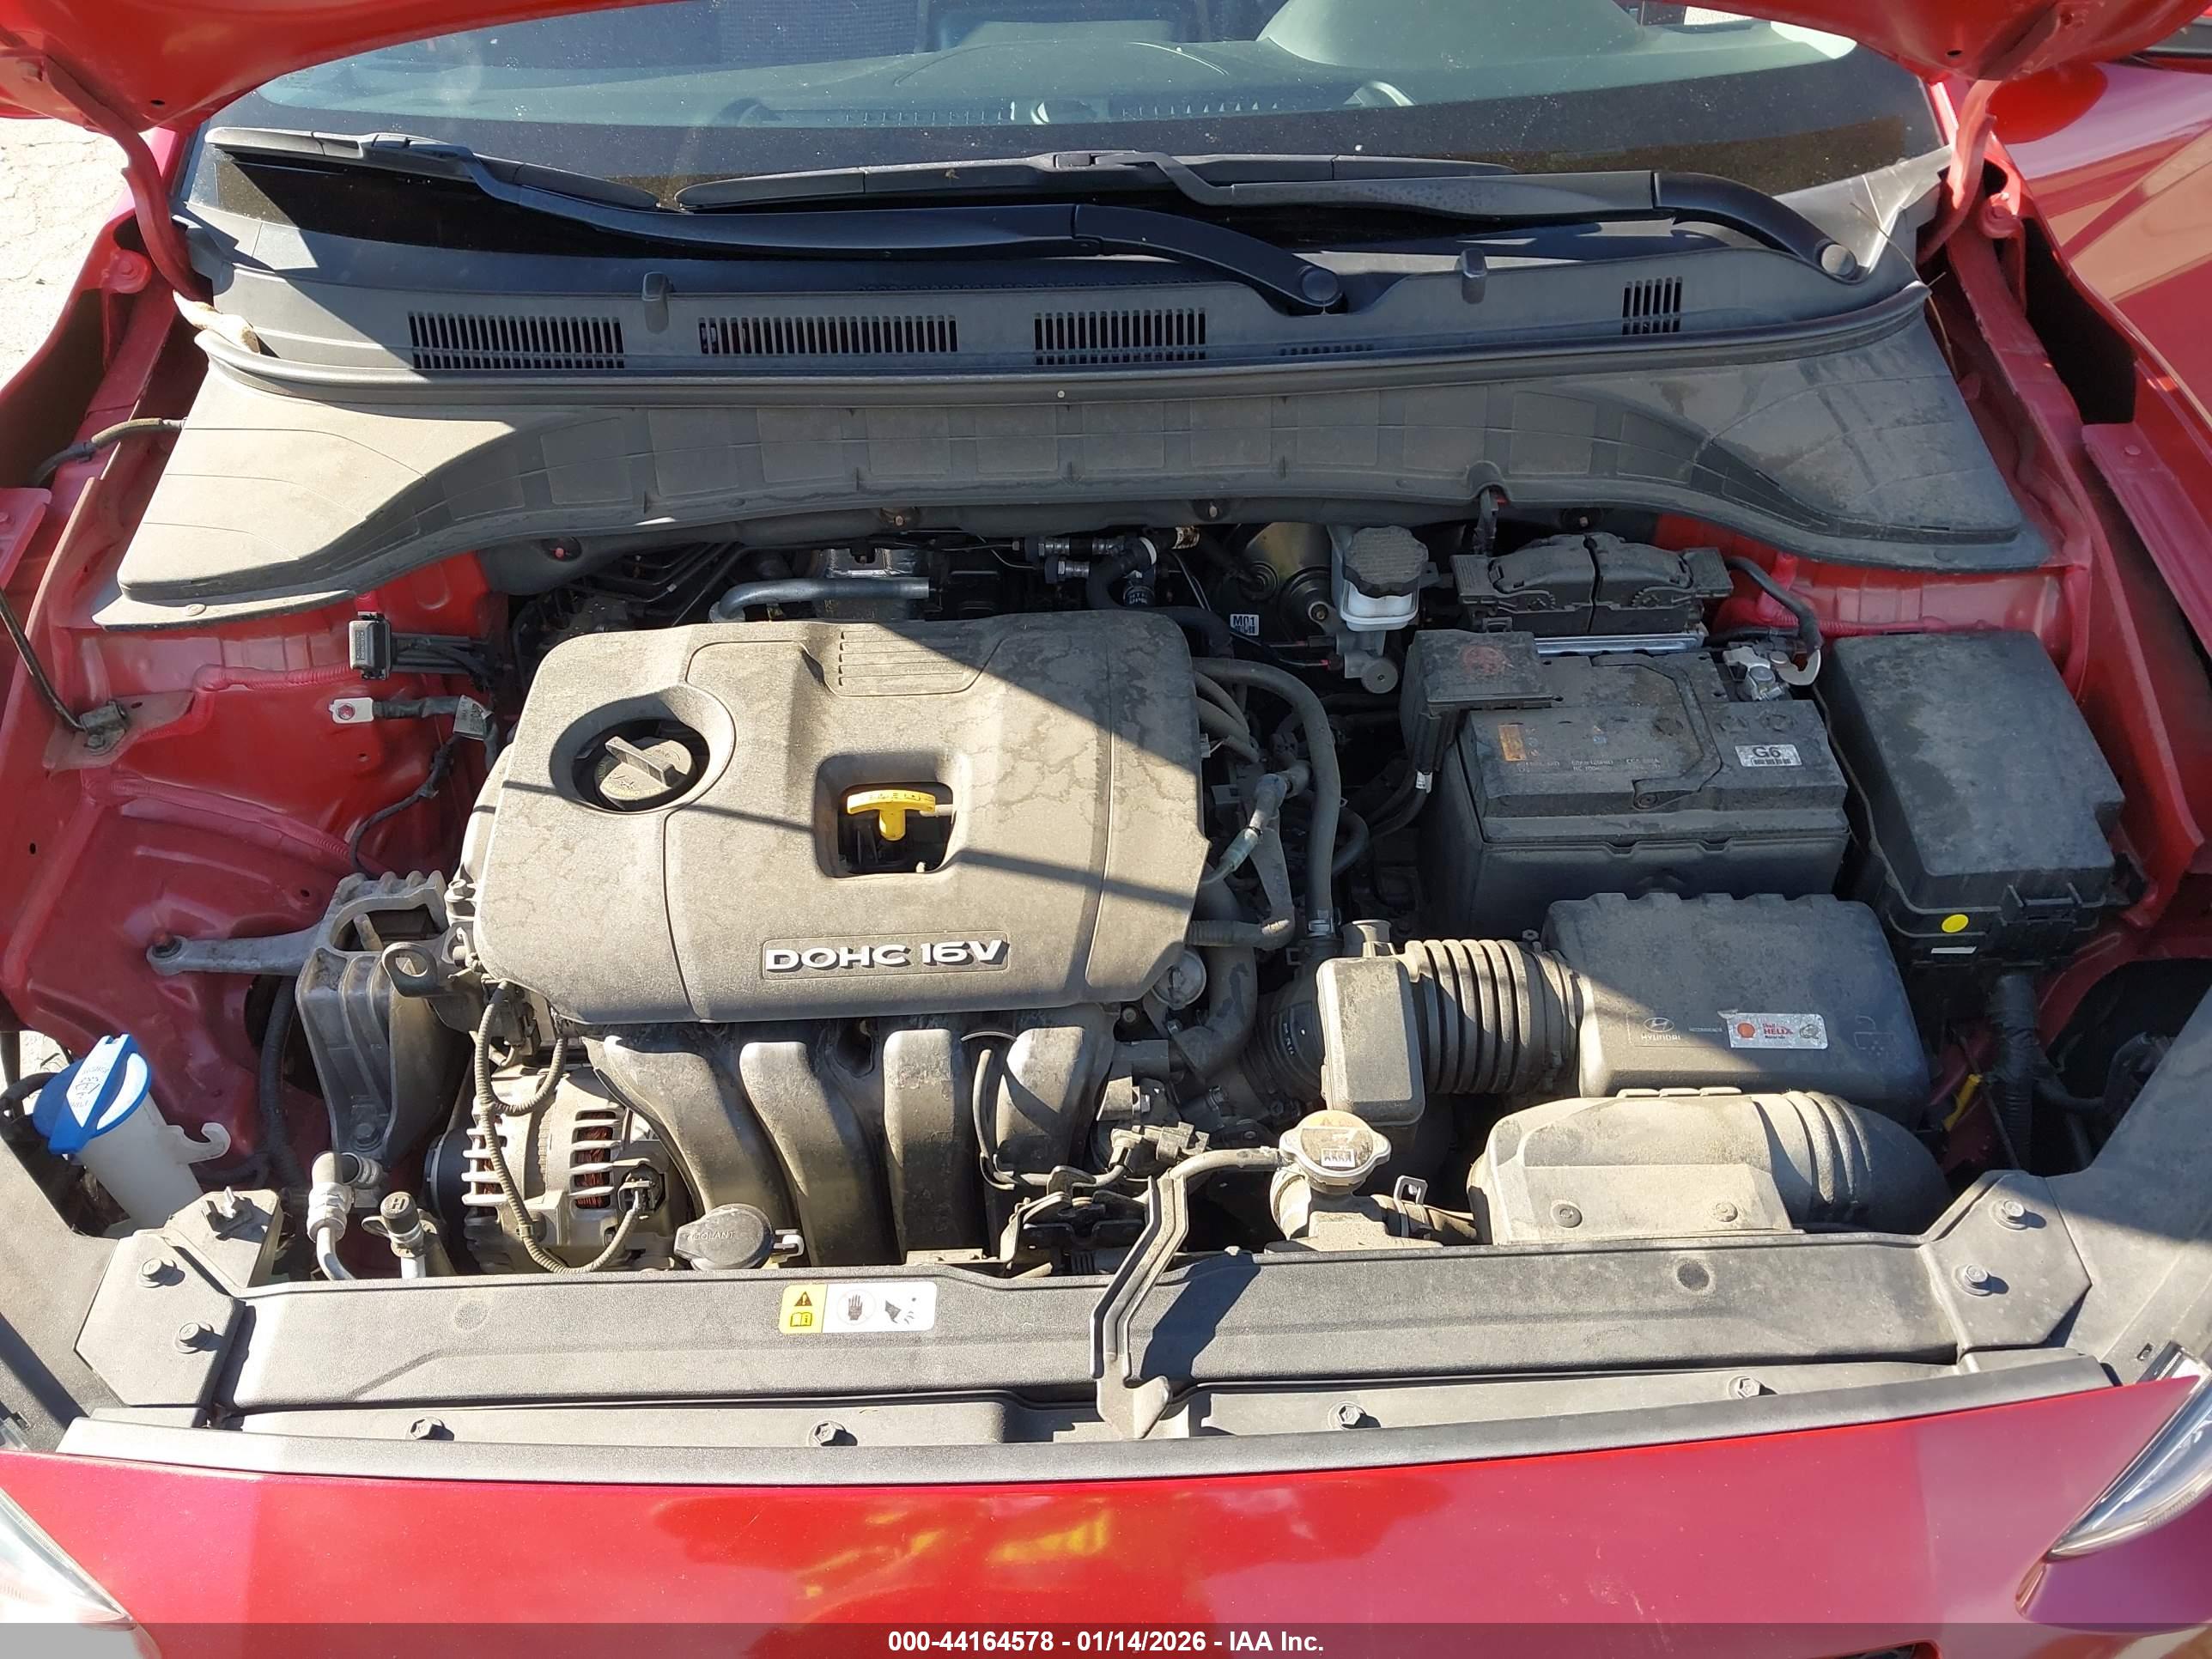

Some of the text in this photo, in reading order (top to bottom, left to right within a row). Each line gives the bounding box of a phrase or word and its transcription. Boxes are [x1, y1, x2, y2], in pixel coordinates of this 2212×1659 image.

[1233, 615, 1255, 626] M01
[1753, 746, 1781, 758] G6
[766, 939, 1007, 971] DOHC 16V
[392, 1198, 405, 1210] H
